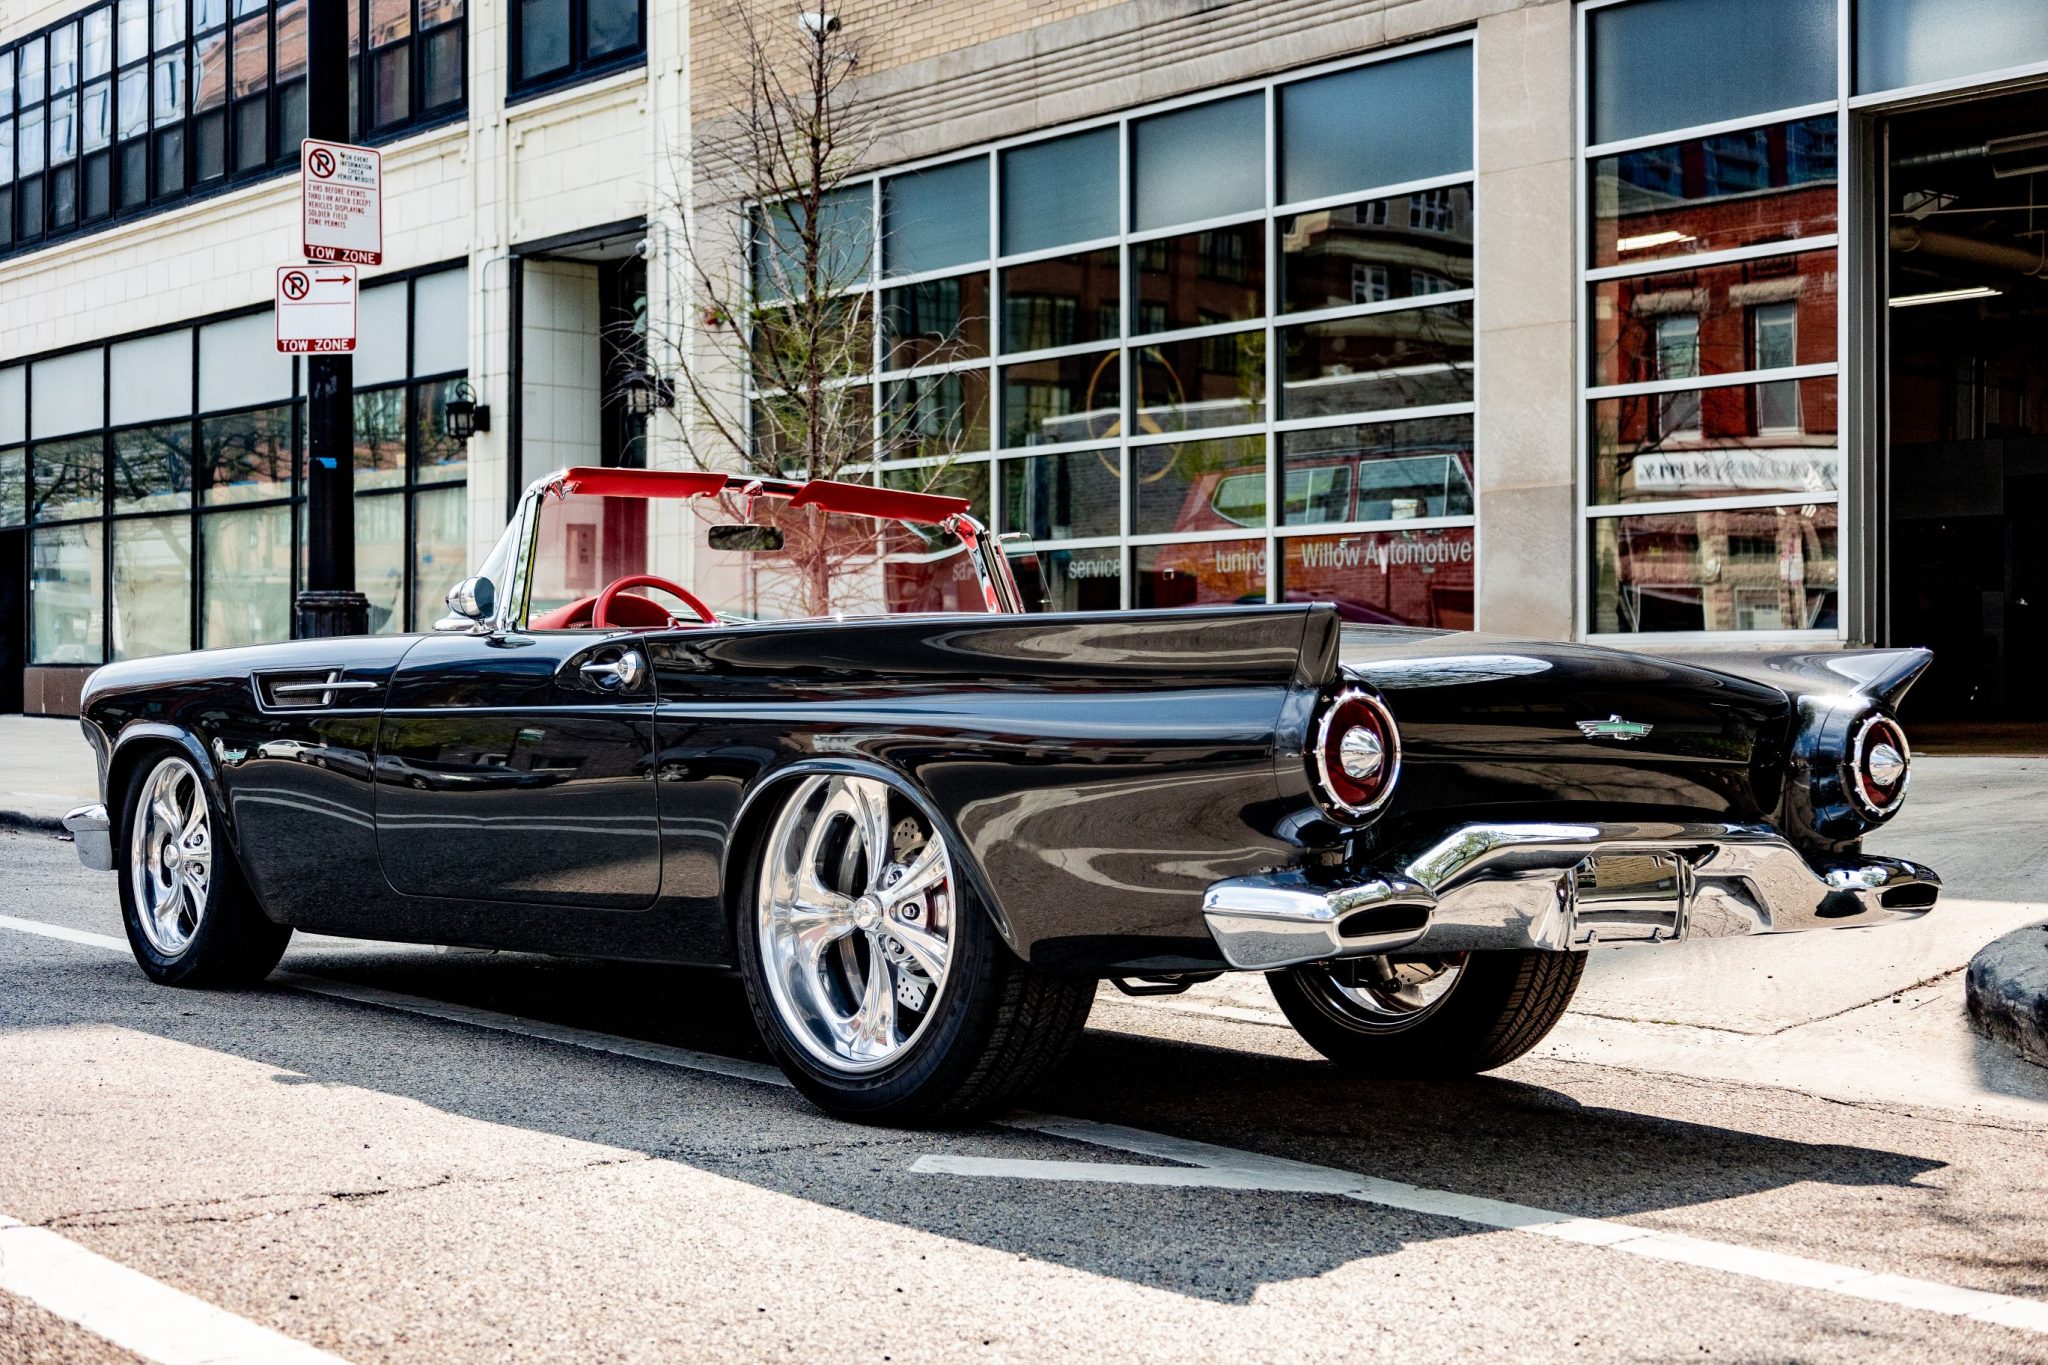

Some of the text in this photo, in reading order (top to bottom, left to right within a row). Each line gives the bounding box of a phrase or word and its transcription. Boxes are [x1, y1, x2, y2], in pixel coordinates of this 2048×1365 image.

[340, 161, 372, 170] INFORMATION
[354, 155, 369, 163] EVENT
[337, 173, 375, 185] VENUE WEBSITE
[313, 185, 323, 193] HRS
[325, 186, 344, 195] BEFORE
[347, 189, 366, 198] EVENTS
[308, 192, 321, 201] THRU
[326, 194, 333, 202] HR
[335, 196, 351, 204] AFTER
[352, 198, 371, 207] EXCEPT
[308, 201, 365, 215] VEHICLES DISPLAYING
[308, 209, 348, 221] SOLDIER FIELD
[308, 217, 346, 230] ZONE PERMITS
[308, 246, 376, 265] TOW ZONE
[282, 338, 349, 352] TOW ZONE
[1301, 537, 1473, 568] Willow Automotive
[1068, 555, 1121, 580] service
[1215, 547, 1267, 575] tuning
